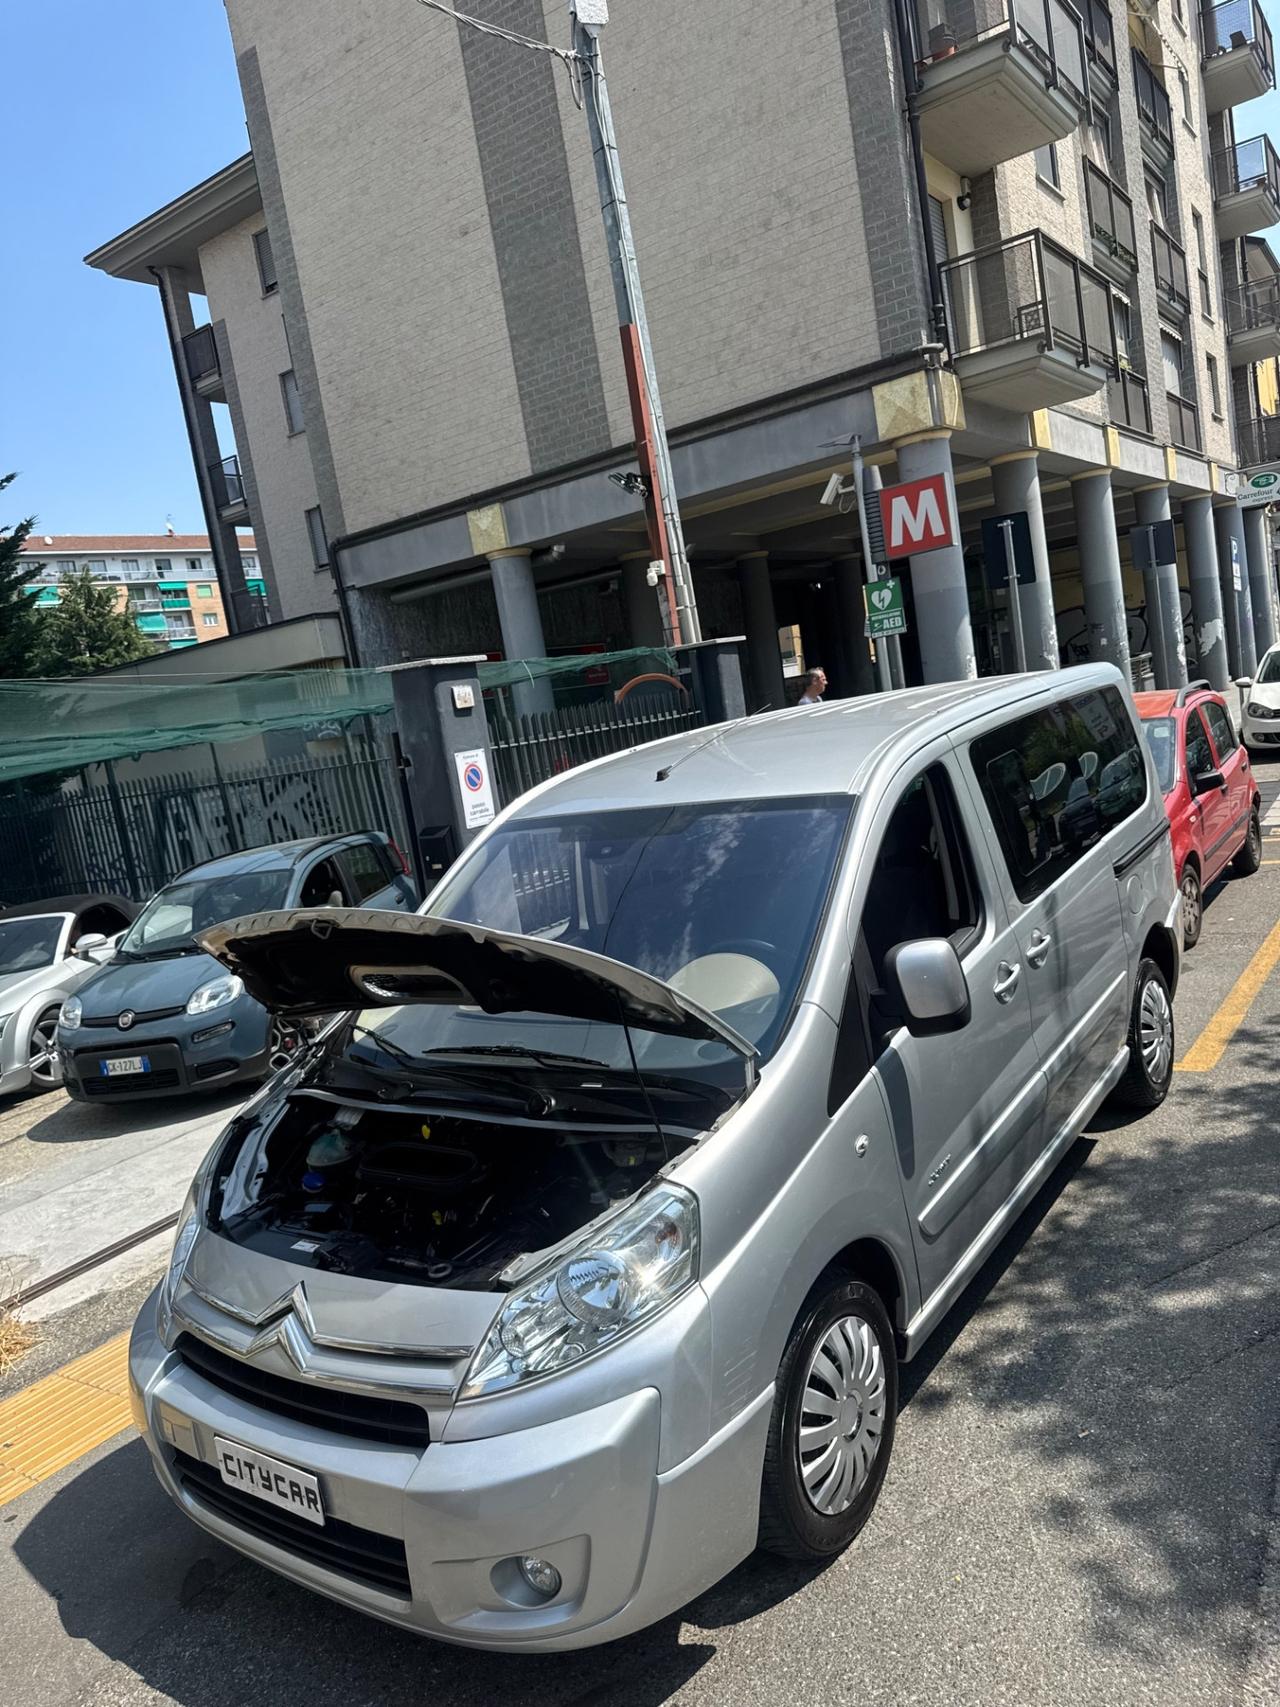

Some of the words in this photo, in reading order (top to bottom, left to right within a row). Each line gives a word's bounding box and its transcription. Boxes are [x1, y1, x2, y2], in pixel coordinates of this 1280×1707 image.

[1237, 489, 1273, 501] Carrefour
[891, 488, 946, 548] M
[883, 616, 902, 629] AED
[222, 1453, 320, 1513] CITYCAR
